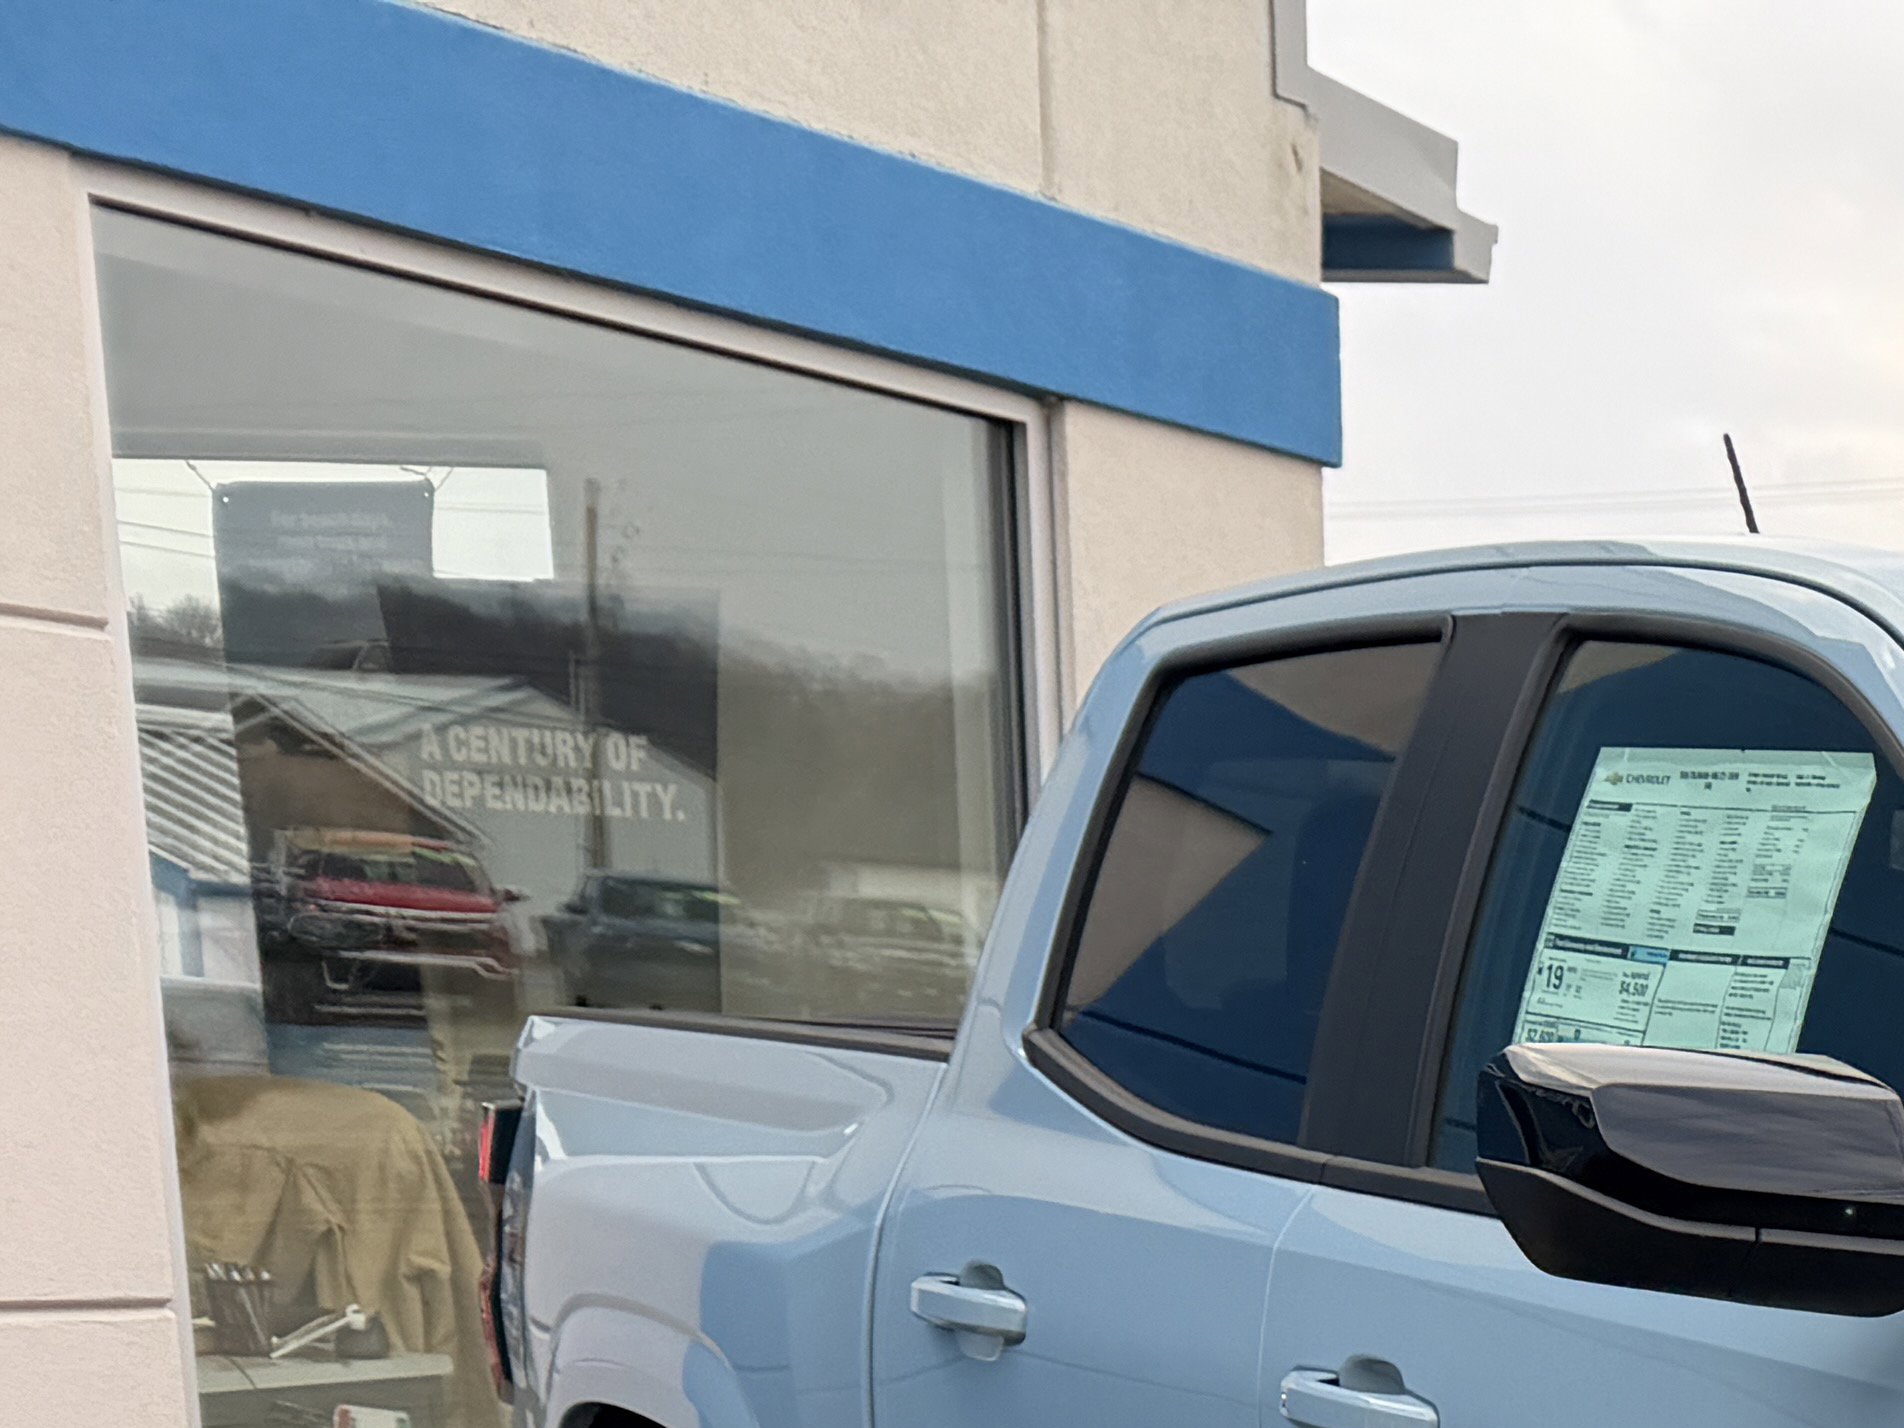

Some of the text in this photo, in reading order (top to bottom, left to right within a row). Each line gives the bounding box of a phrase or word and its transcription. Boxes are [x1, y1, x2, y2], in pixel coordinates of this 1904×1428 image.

[419, 724, 650, 772] A CENTURY OF
[421, 769, 686, 821] DEPENDABILITY.
[1625, 773, 1671, 786] CHEVROLET
